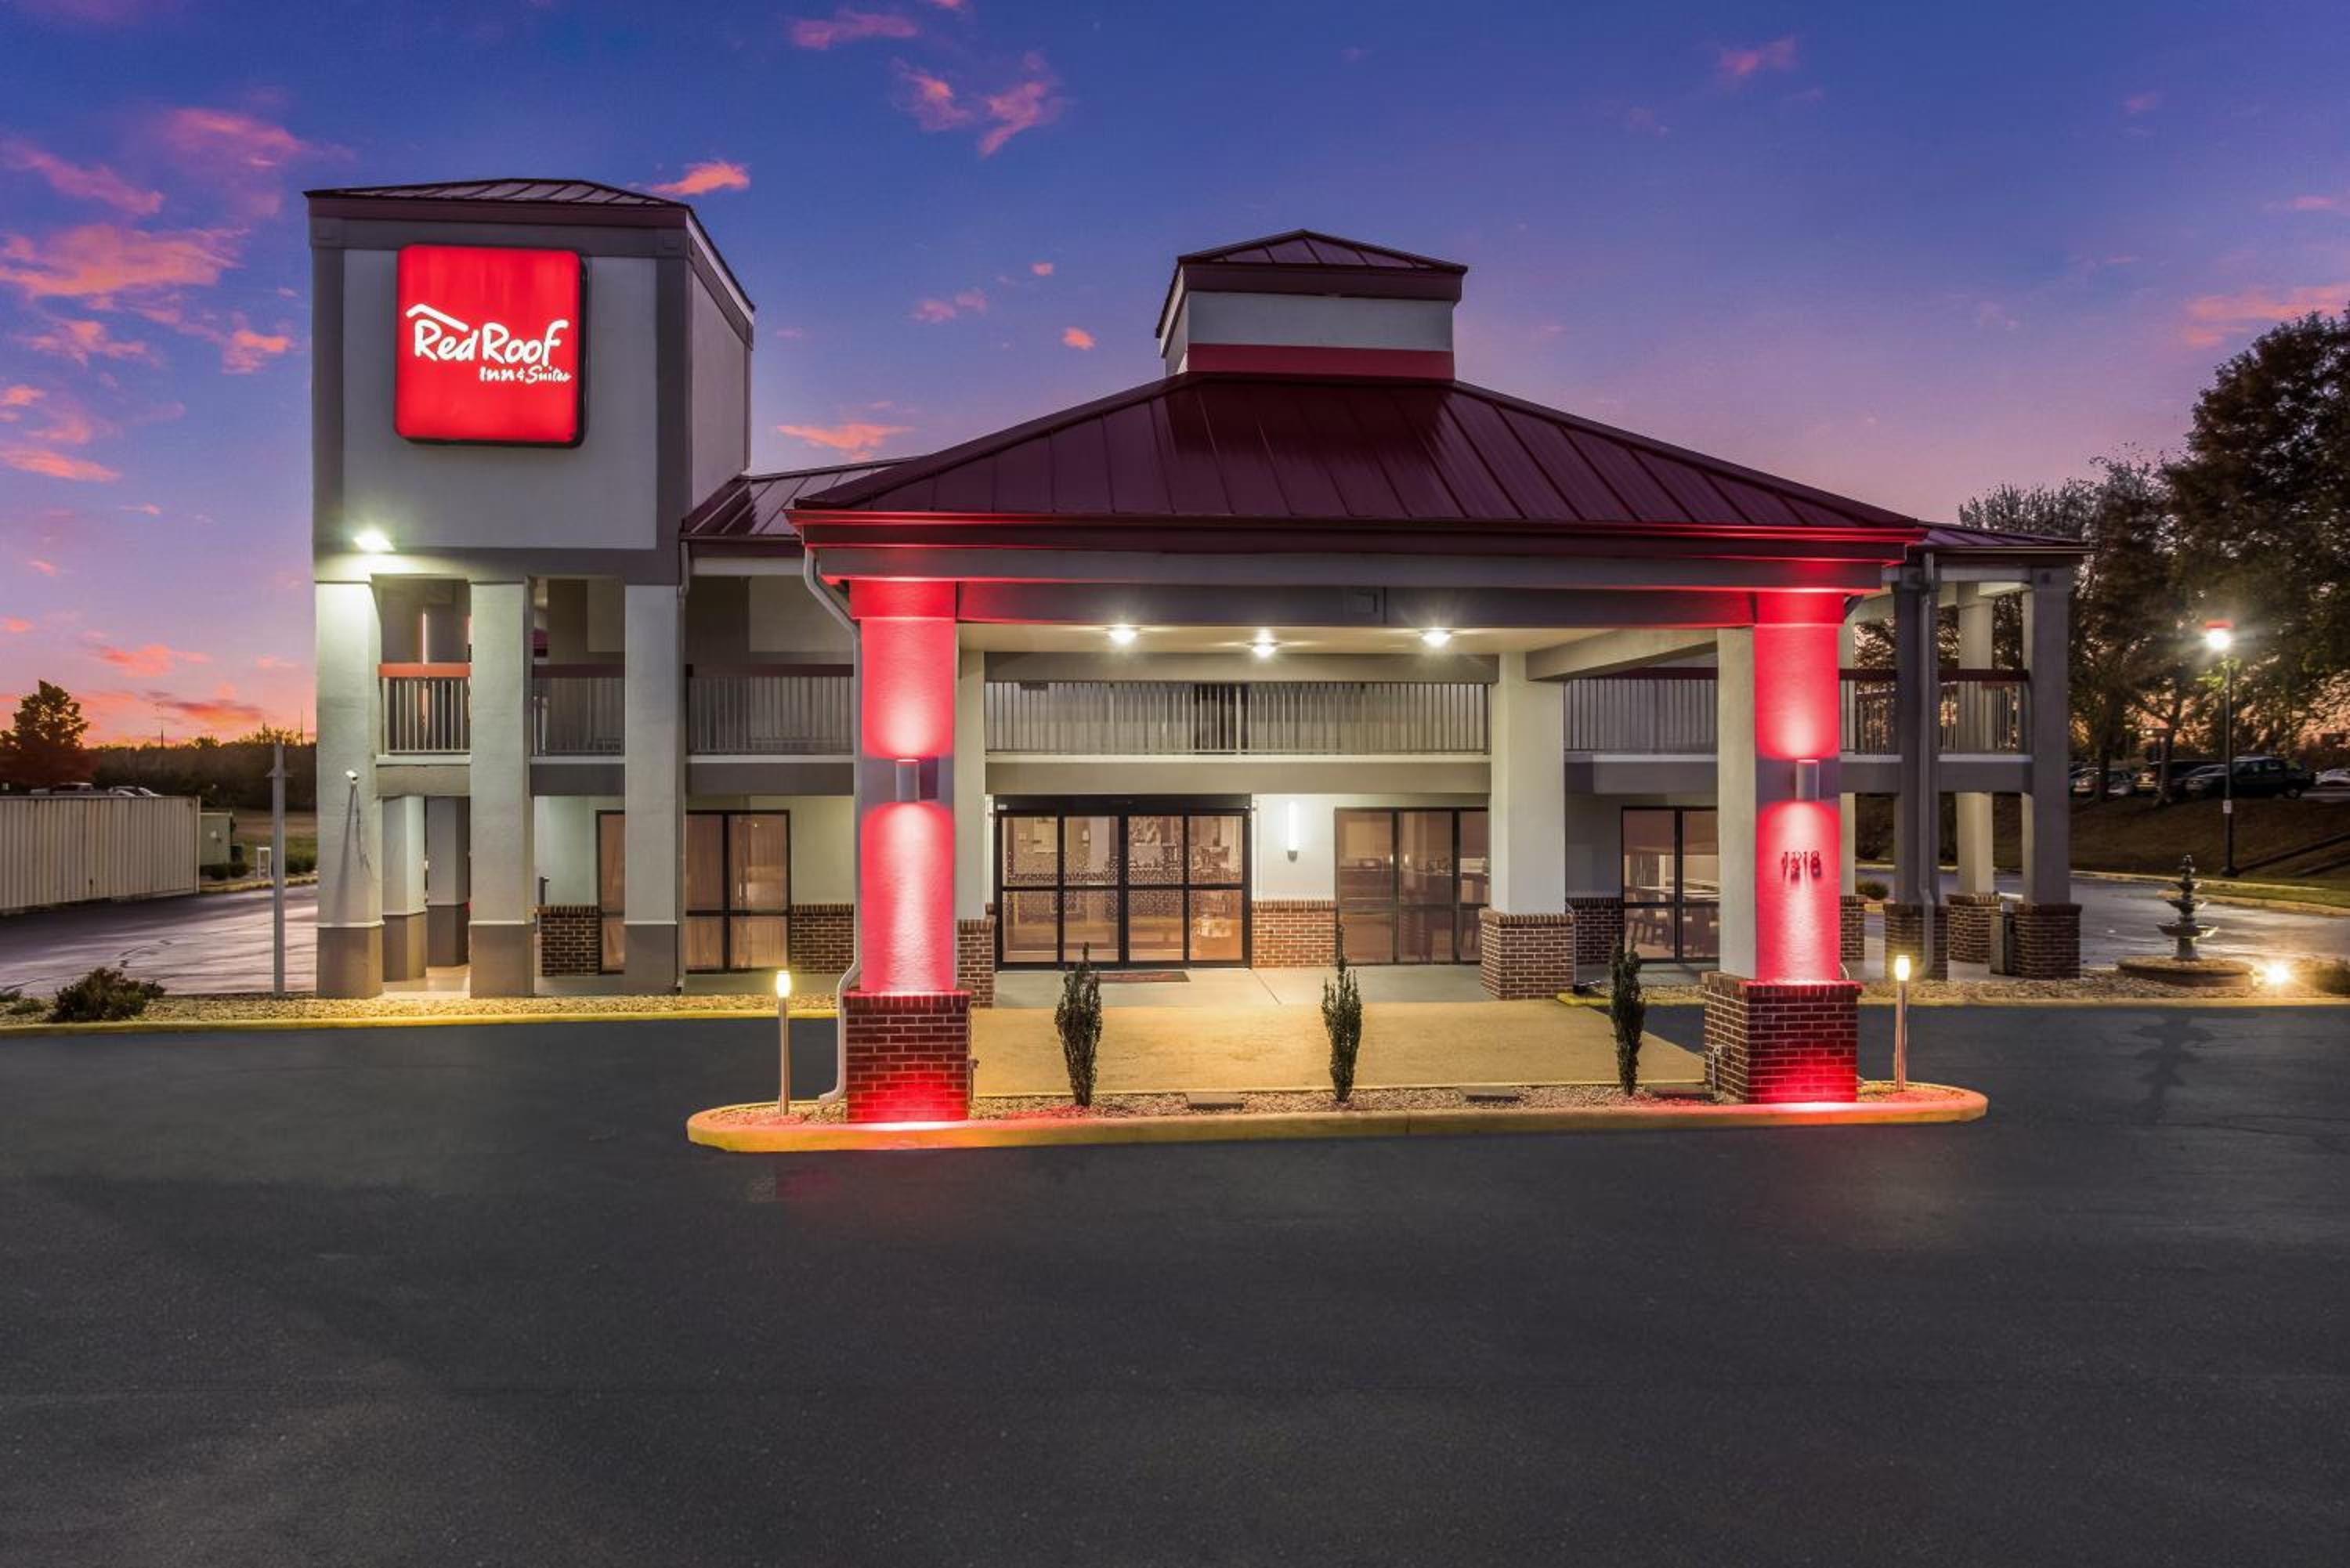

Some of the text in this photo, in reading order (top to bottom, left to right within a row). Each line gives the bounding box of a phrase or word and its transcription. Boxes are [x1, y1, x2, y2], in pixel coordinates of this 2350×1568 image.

[414, 320, 569, 367] Red Roof
[479, 366, 514, 381] Inn
[526, 364, 571, 385] Suites
